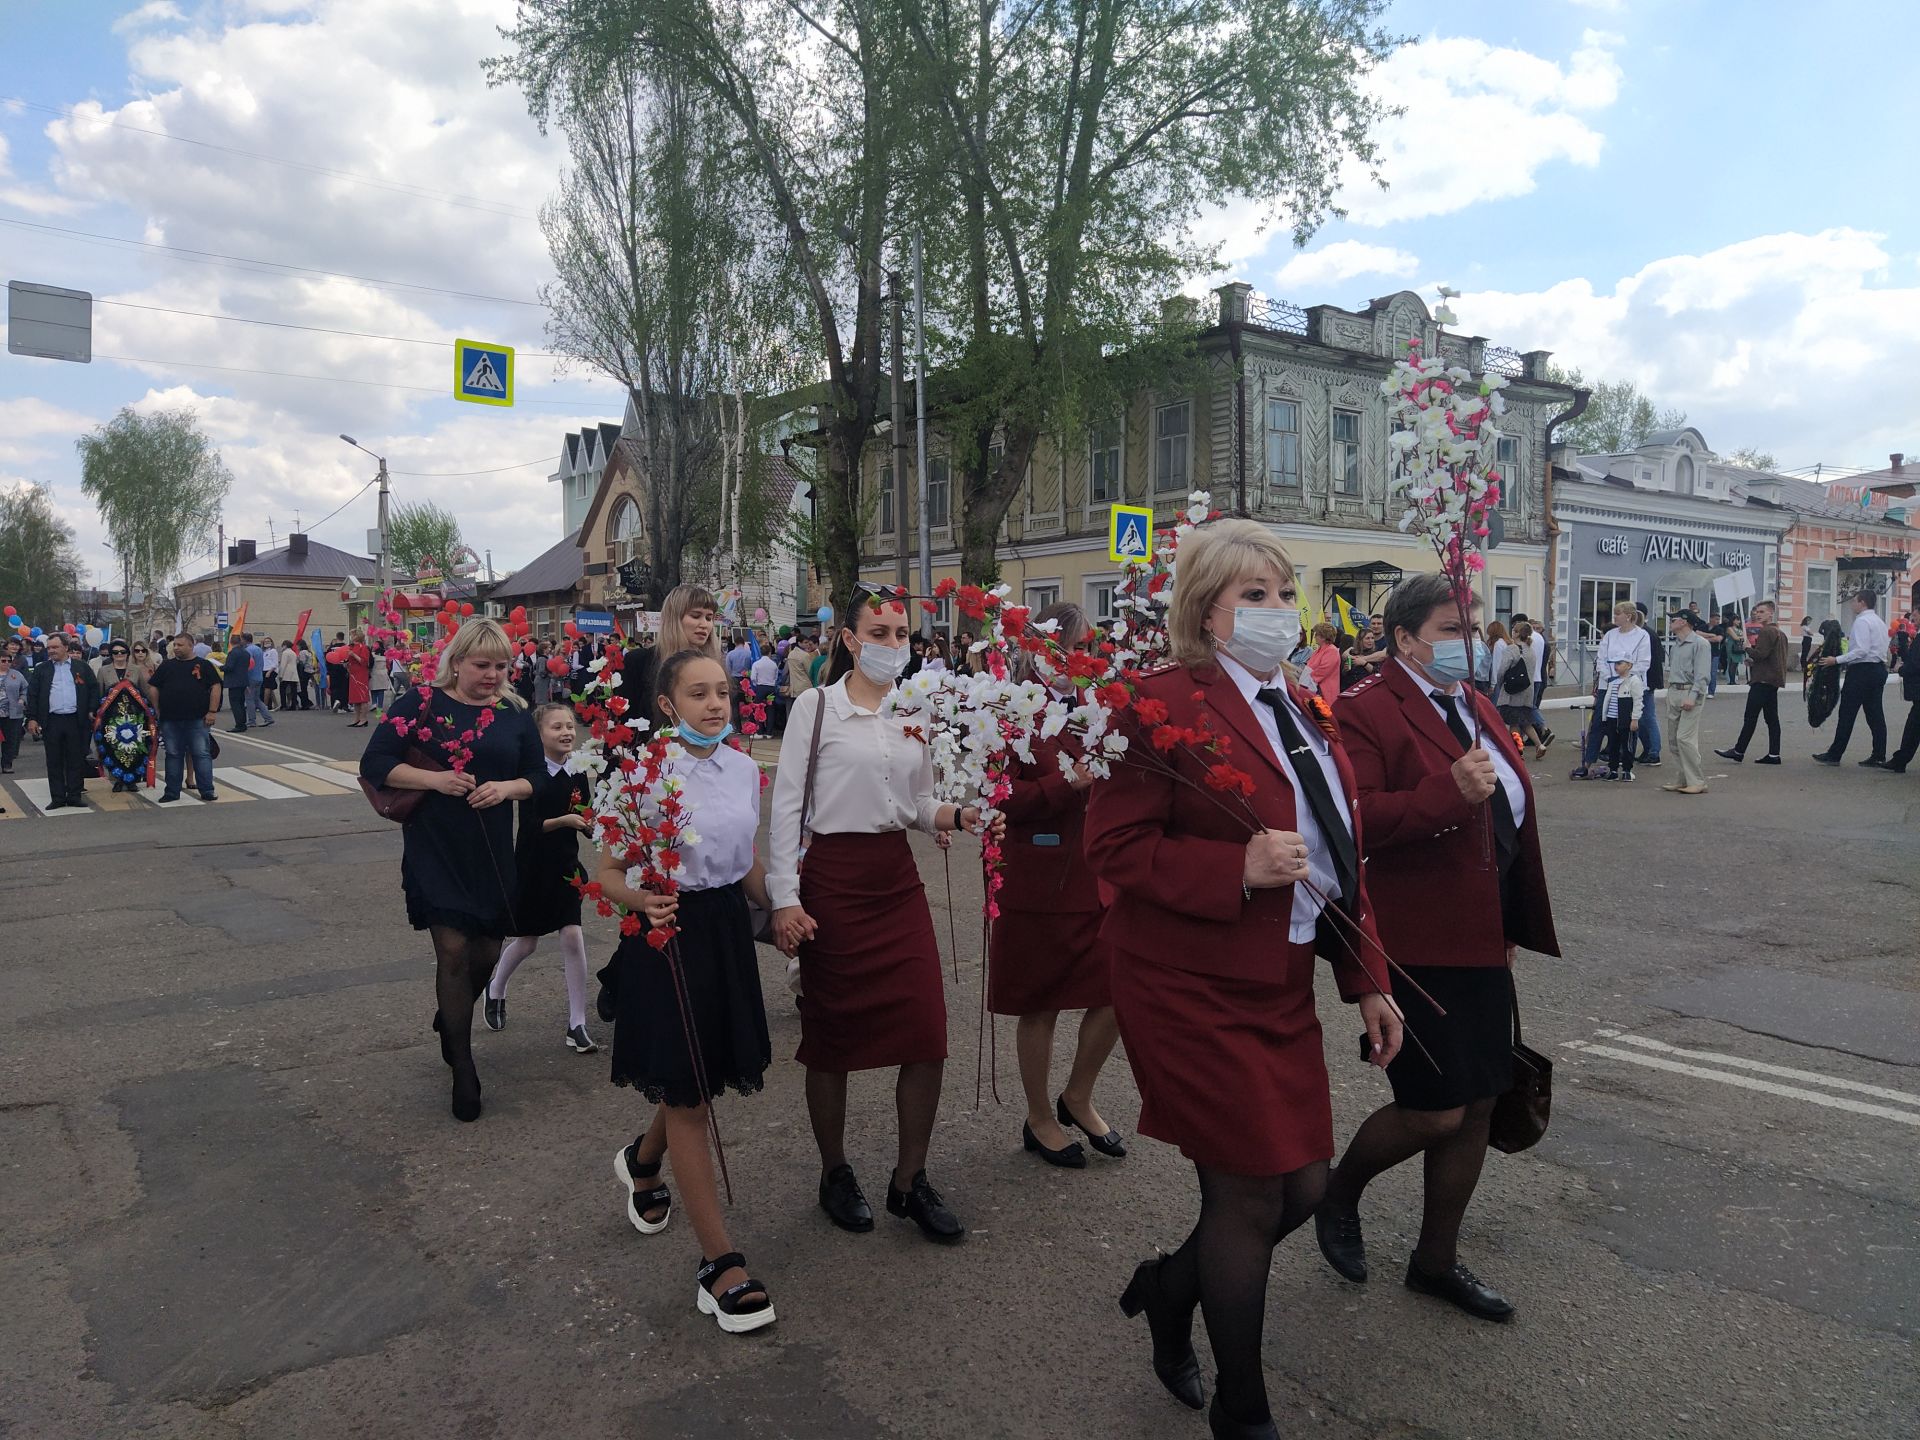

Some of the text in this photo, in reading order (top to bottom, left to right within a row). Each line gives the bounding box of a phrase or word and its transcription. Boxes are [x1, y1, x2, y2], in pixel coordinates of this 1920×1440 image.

[1599, 535, 1629, 555] café
[1642, 534, 1715, 568] AVENUE
[1721, 549, 1751, 571] кафе
